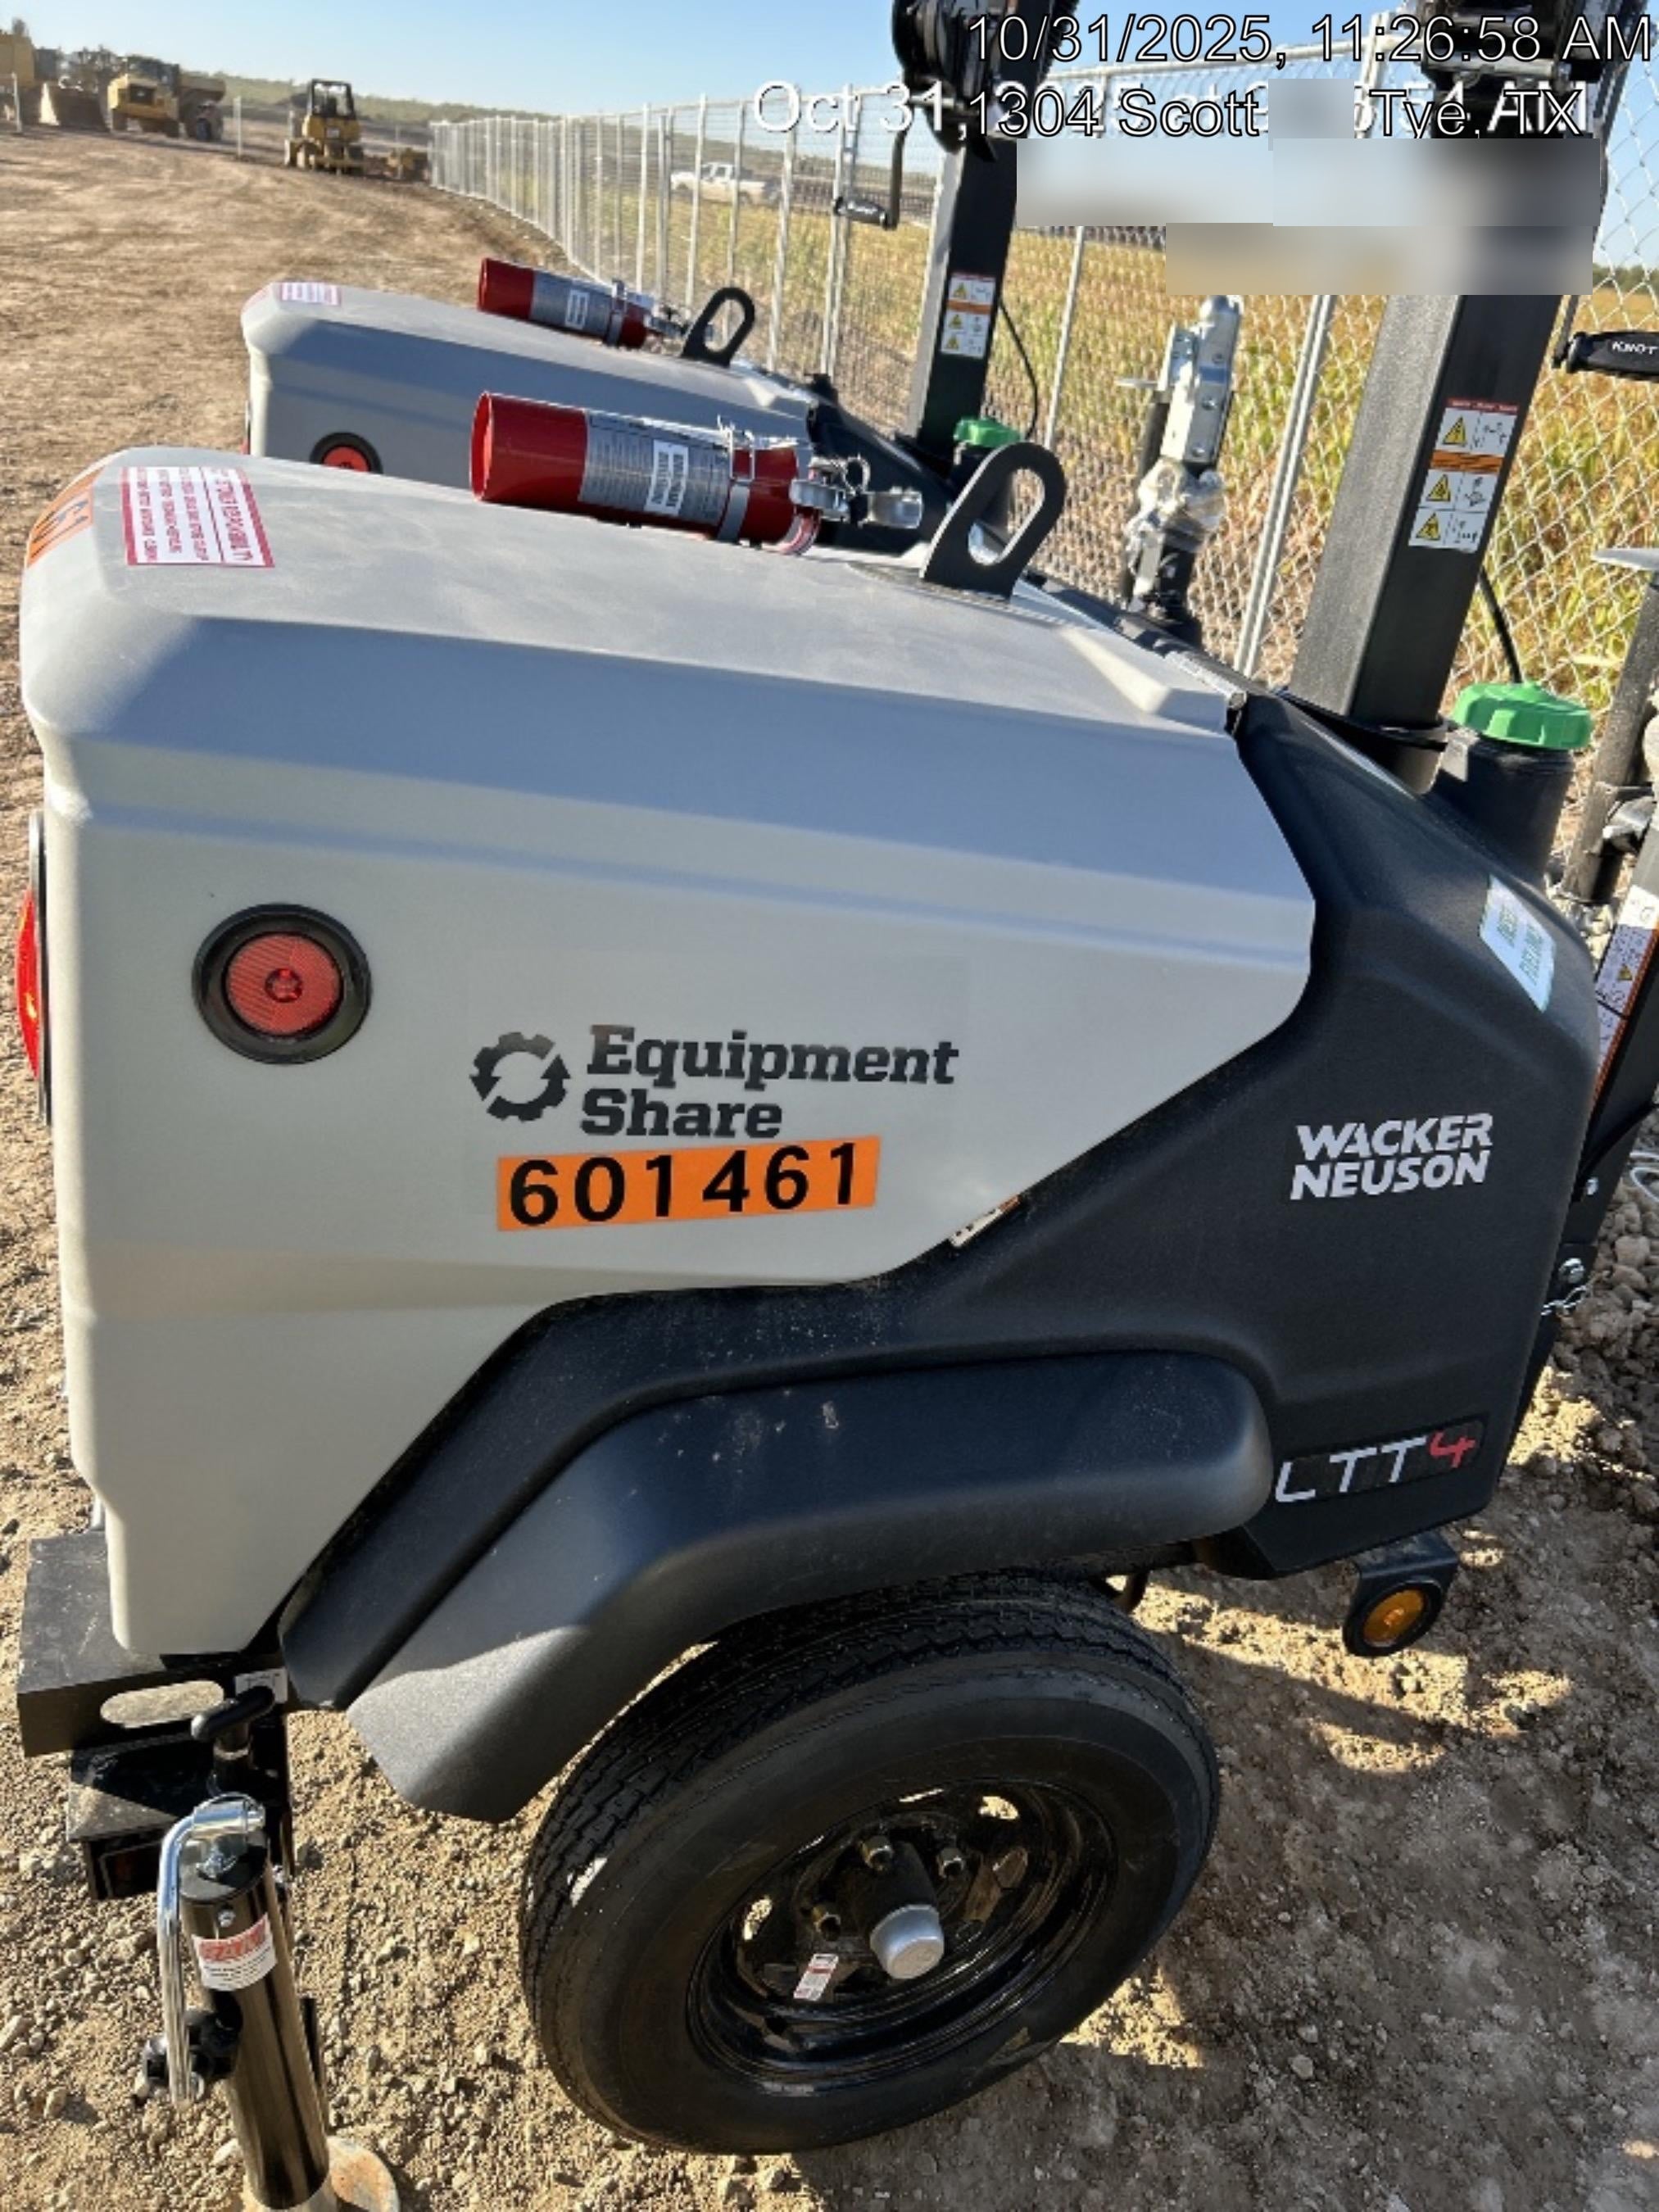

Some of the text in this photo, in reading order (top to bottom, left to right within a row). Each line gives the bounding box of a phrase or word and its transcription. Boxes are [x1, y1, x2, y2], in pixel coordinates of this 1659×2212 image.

[587, 1024, 959, 1091] Equipment
[581, 1087, 783, 1139] Share
[1295, 1113, 1494, 1162] WACKER
[509, 1142, 857, 1226] 601461
[1290, 1150, 1491, 1201] NEUSON
